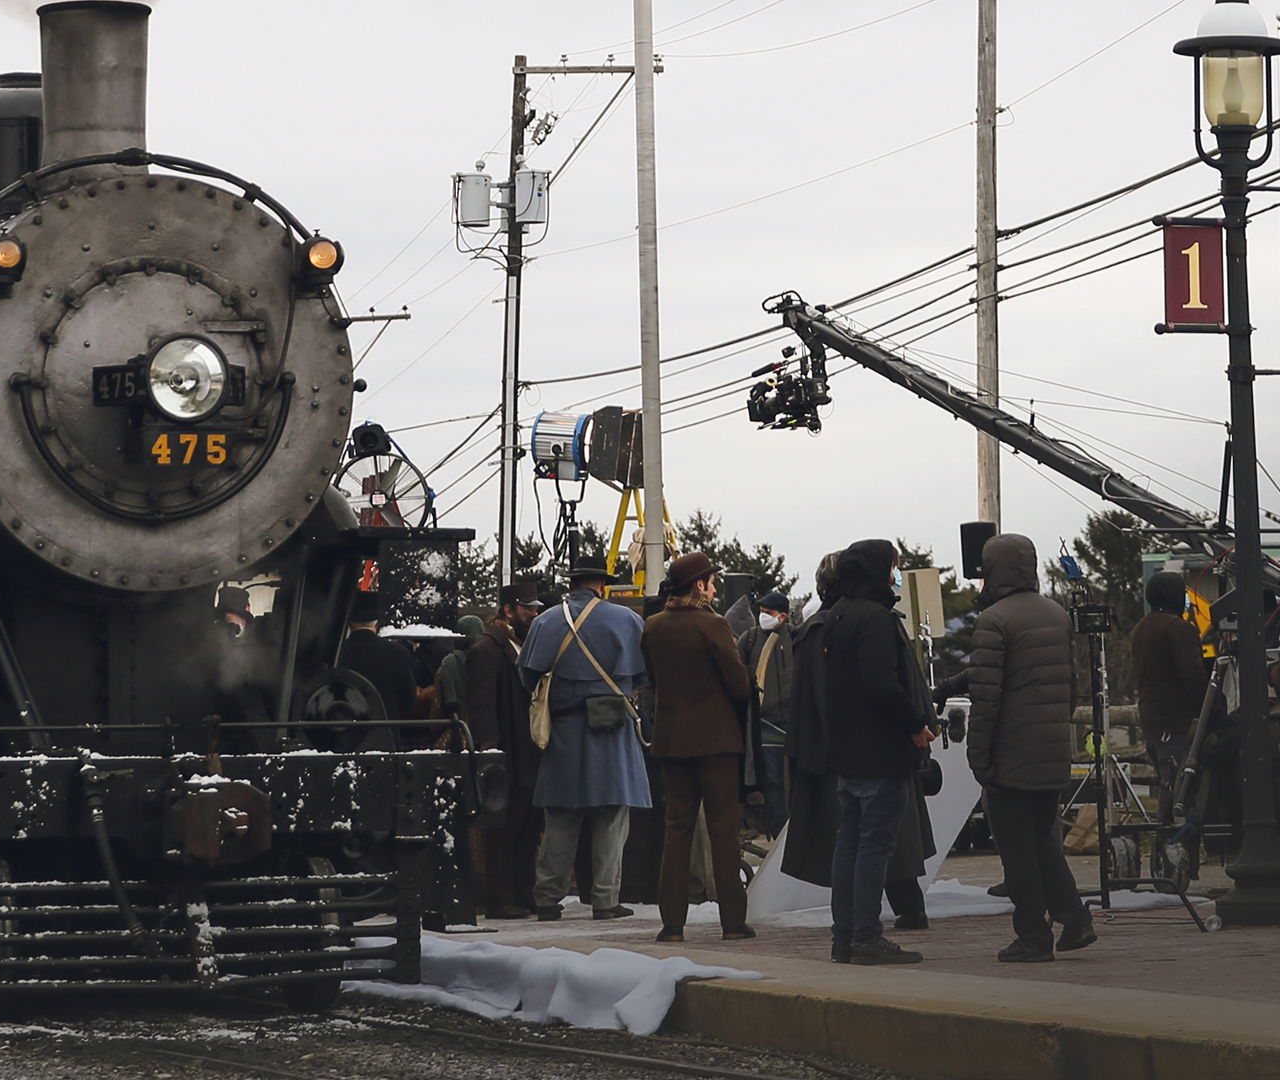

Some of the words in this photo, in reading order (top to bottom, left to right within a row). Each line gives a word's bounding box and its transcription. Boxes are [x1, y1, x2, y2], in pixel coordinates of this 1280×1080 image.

[1181, 241, 1209, 309] 1
[99, 371, 136, 399] 475
[151, 433, 228, 465] 475
